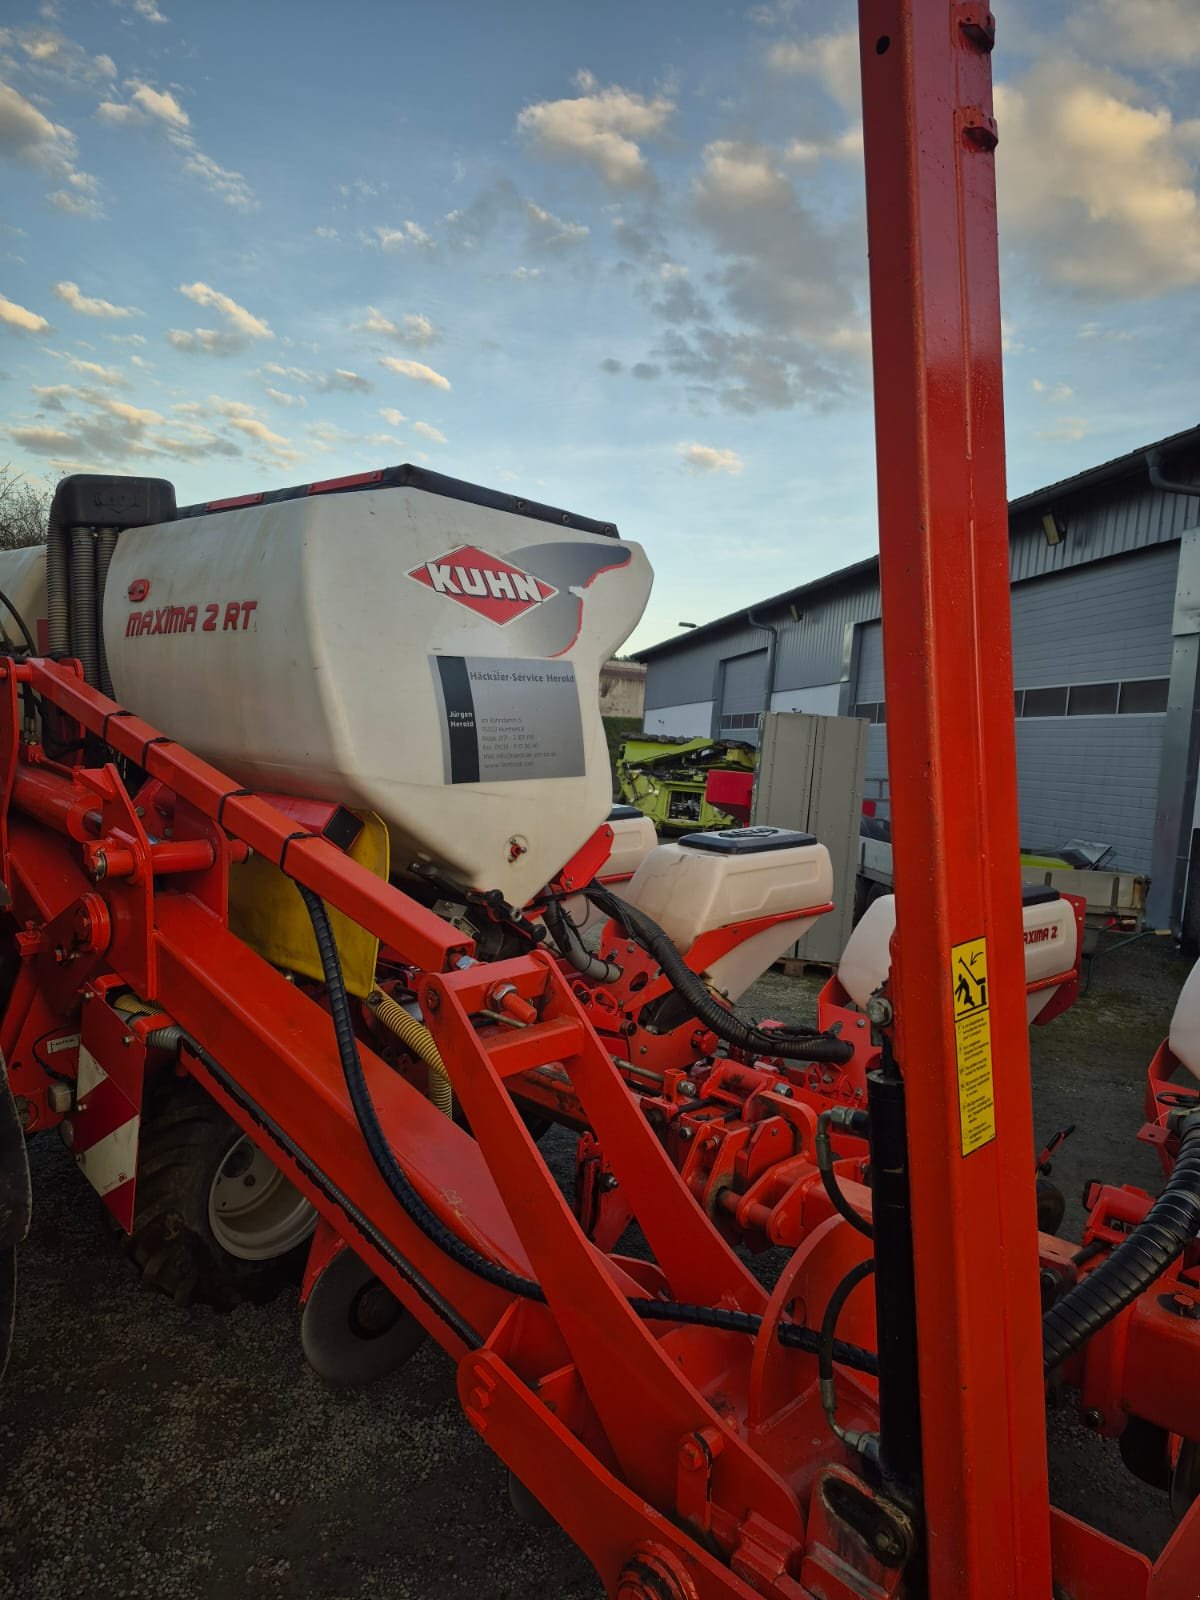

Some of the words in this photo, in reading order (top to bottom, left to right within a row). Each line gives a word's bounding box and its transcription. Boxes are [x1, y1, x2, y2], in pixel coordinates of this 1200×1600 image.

[425, 562, 544, 603] KUHN
[125, 605, 199, 638] MAXIMA
[202, 604, 220, 632] 2
[223, 601, 257, 631] RT
[546, 672, 576, 684] Herold
[449, 711, 473, 719] Jürgen
[450, 718, 474, 728] Herold
[1023, 927, 1049, 945] AXIMA
[1051, 925, 1058, 939] 2
